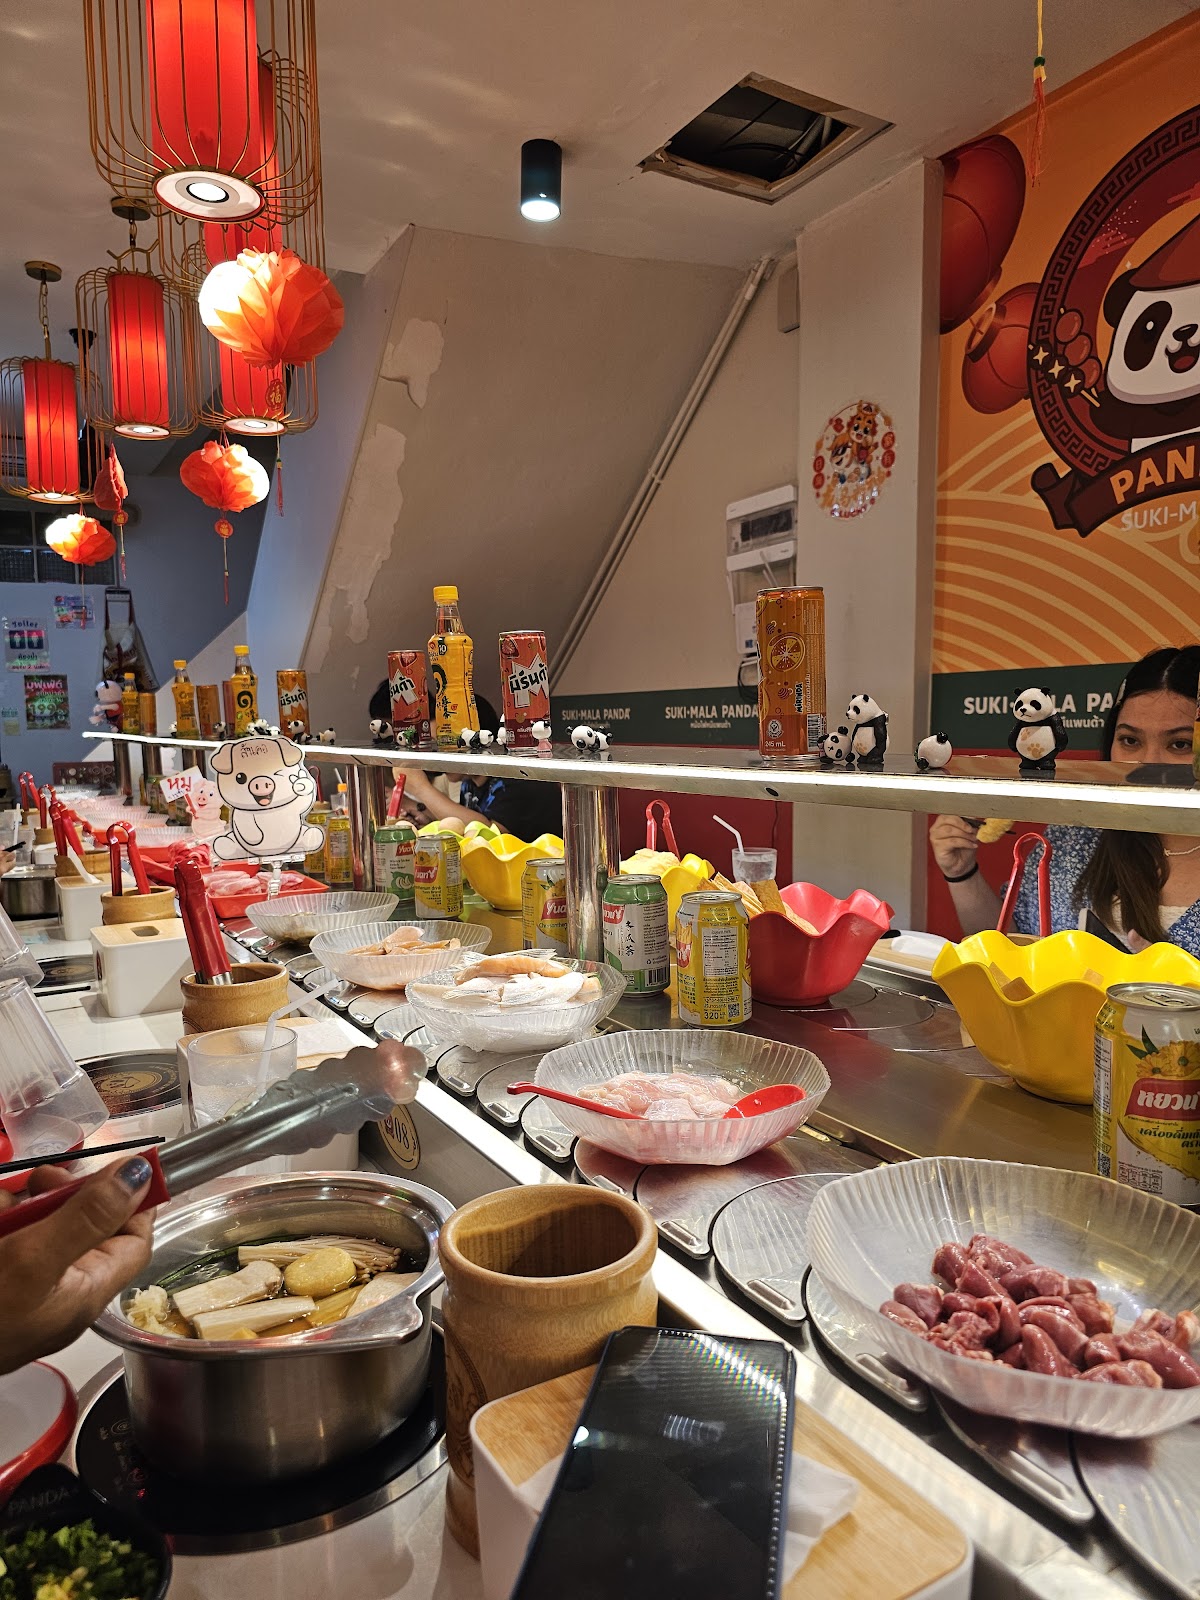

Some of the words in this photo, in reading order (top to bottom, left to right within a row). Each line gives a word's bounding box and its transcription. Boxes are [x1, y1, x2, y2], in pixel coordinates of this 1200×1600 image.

[1109, 445, 1199, 504] PAN
[1120, 501, 1197, 531] SUKI-M
[1086, 692, 1116, 713] PA
[546, 902, 567, 916] Yua
[704, 1011, 719, 1020] 320
